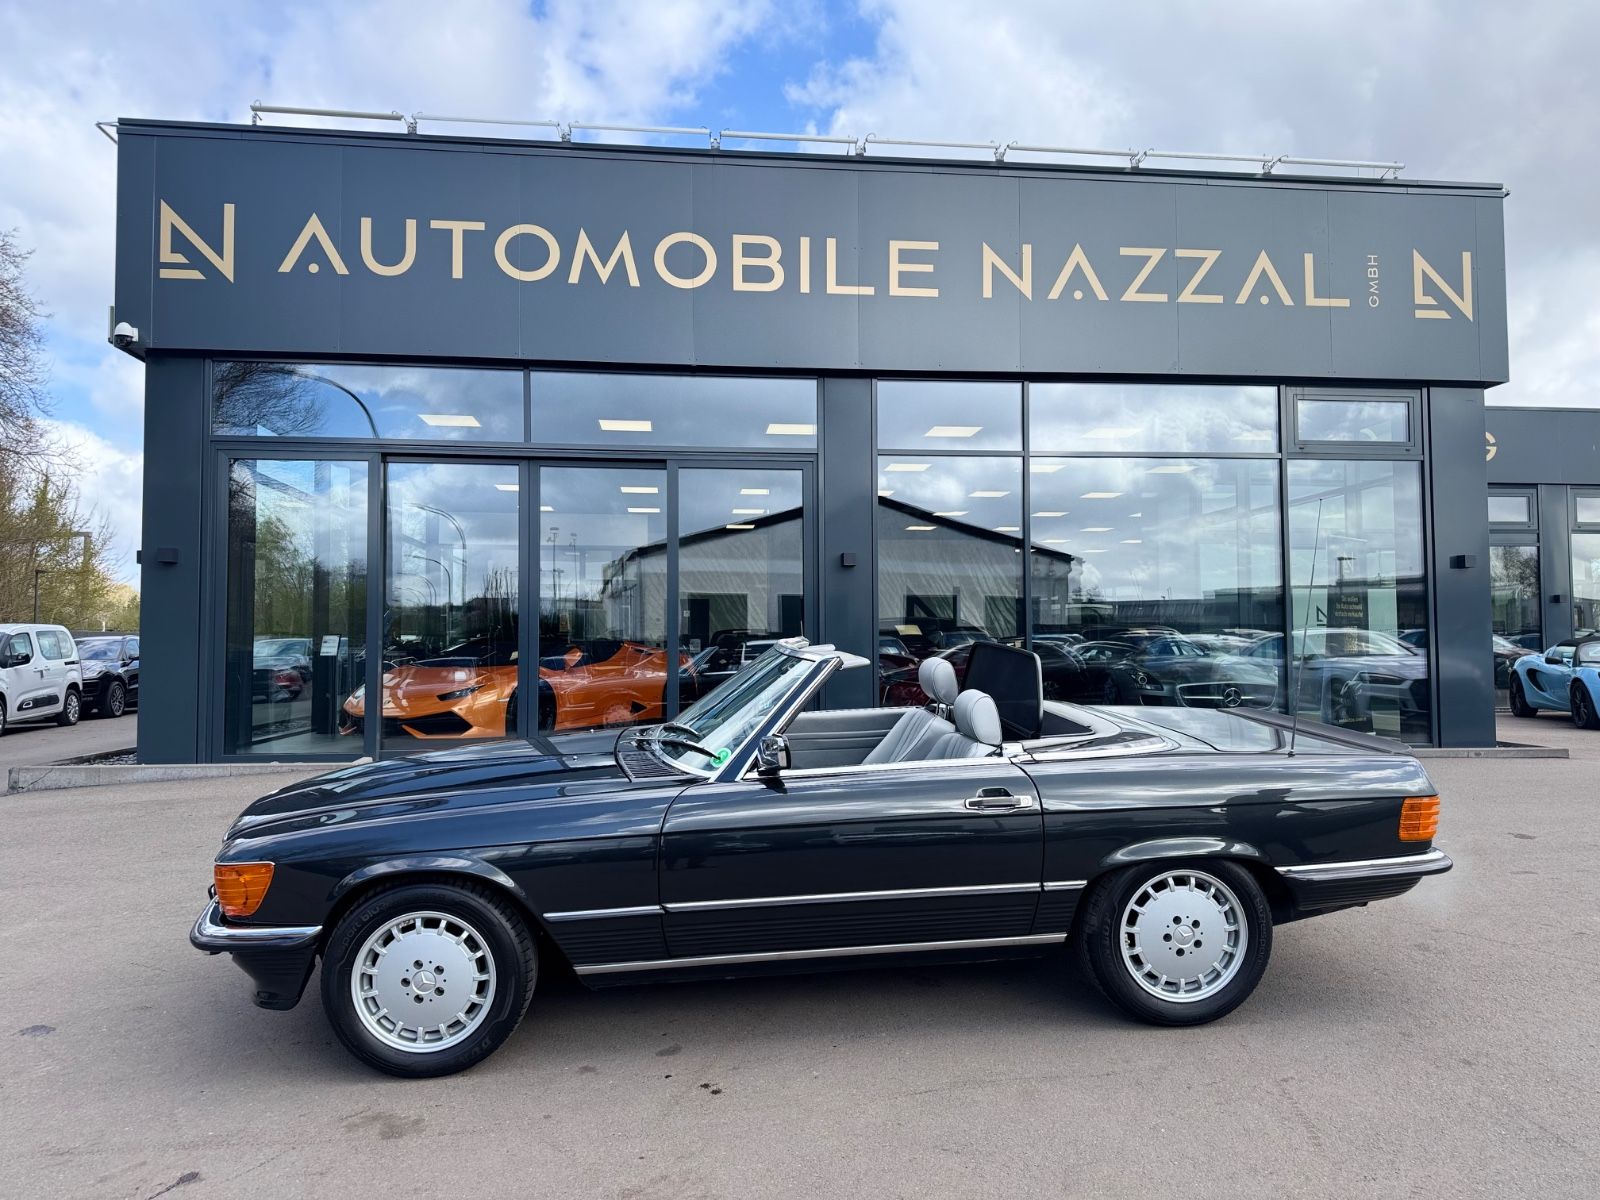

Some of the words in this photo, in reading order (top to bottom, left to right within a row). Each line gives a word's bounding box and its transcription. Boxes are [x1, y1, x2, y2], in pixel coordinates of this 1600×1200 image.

[278, 212, 939, 298] AUTOMOBILE
[981, 242, 1351, 308] NAZZAL
[1367, 254, 1380, 308] GMBH
